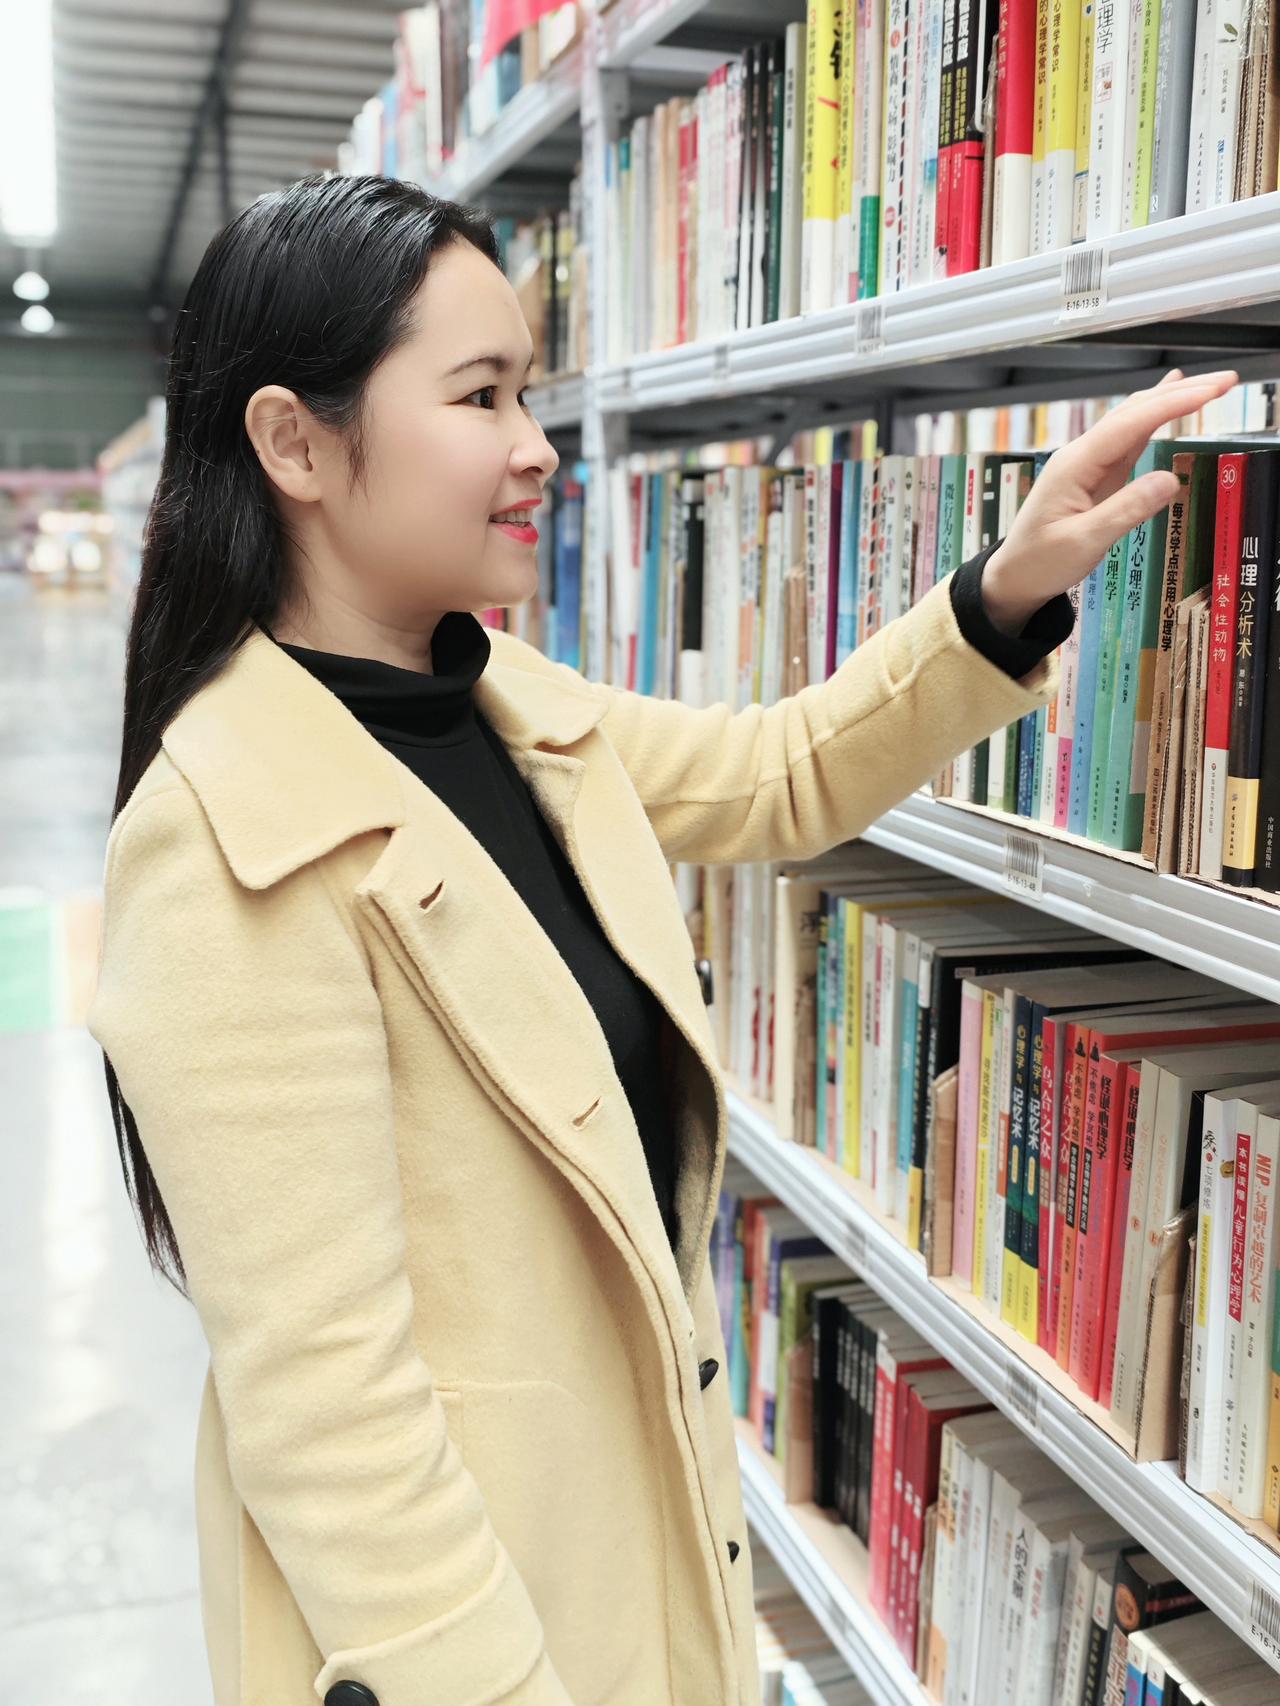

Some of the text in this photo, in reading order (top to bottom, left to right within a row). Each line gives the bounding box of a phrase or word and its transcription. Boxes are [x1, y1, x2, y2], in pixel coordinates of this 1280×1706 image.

[1095, 0, 1115, 54] 理学
[1222, 469, 1236, 484] 30
[940, 483, 955, 577] 微行为心理
[1105, 543, 1121, 601] 心理学
[1126, 520, 1147, 612] 为心理学
[1160, 502, 1185, 652] 每天学点实用心理学
[1212, 573, 1231, 662] 社会性动物
[1236, 536, 1260, 659] 心理分析术
[1264, 816, 1275, 869] 中国商业出版社
[1011, 1087, 1025, 1138] 记忆术
[1028, 1097, 1041, 1150] 记忆术
[1040, 1065, 1054, 1160] 乌合之众
[1229, 1135, 1250, 1315] 一本书读懂儿童行为心理学
